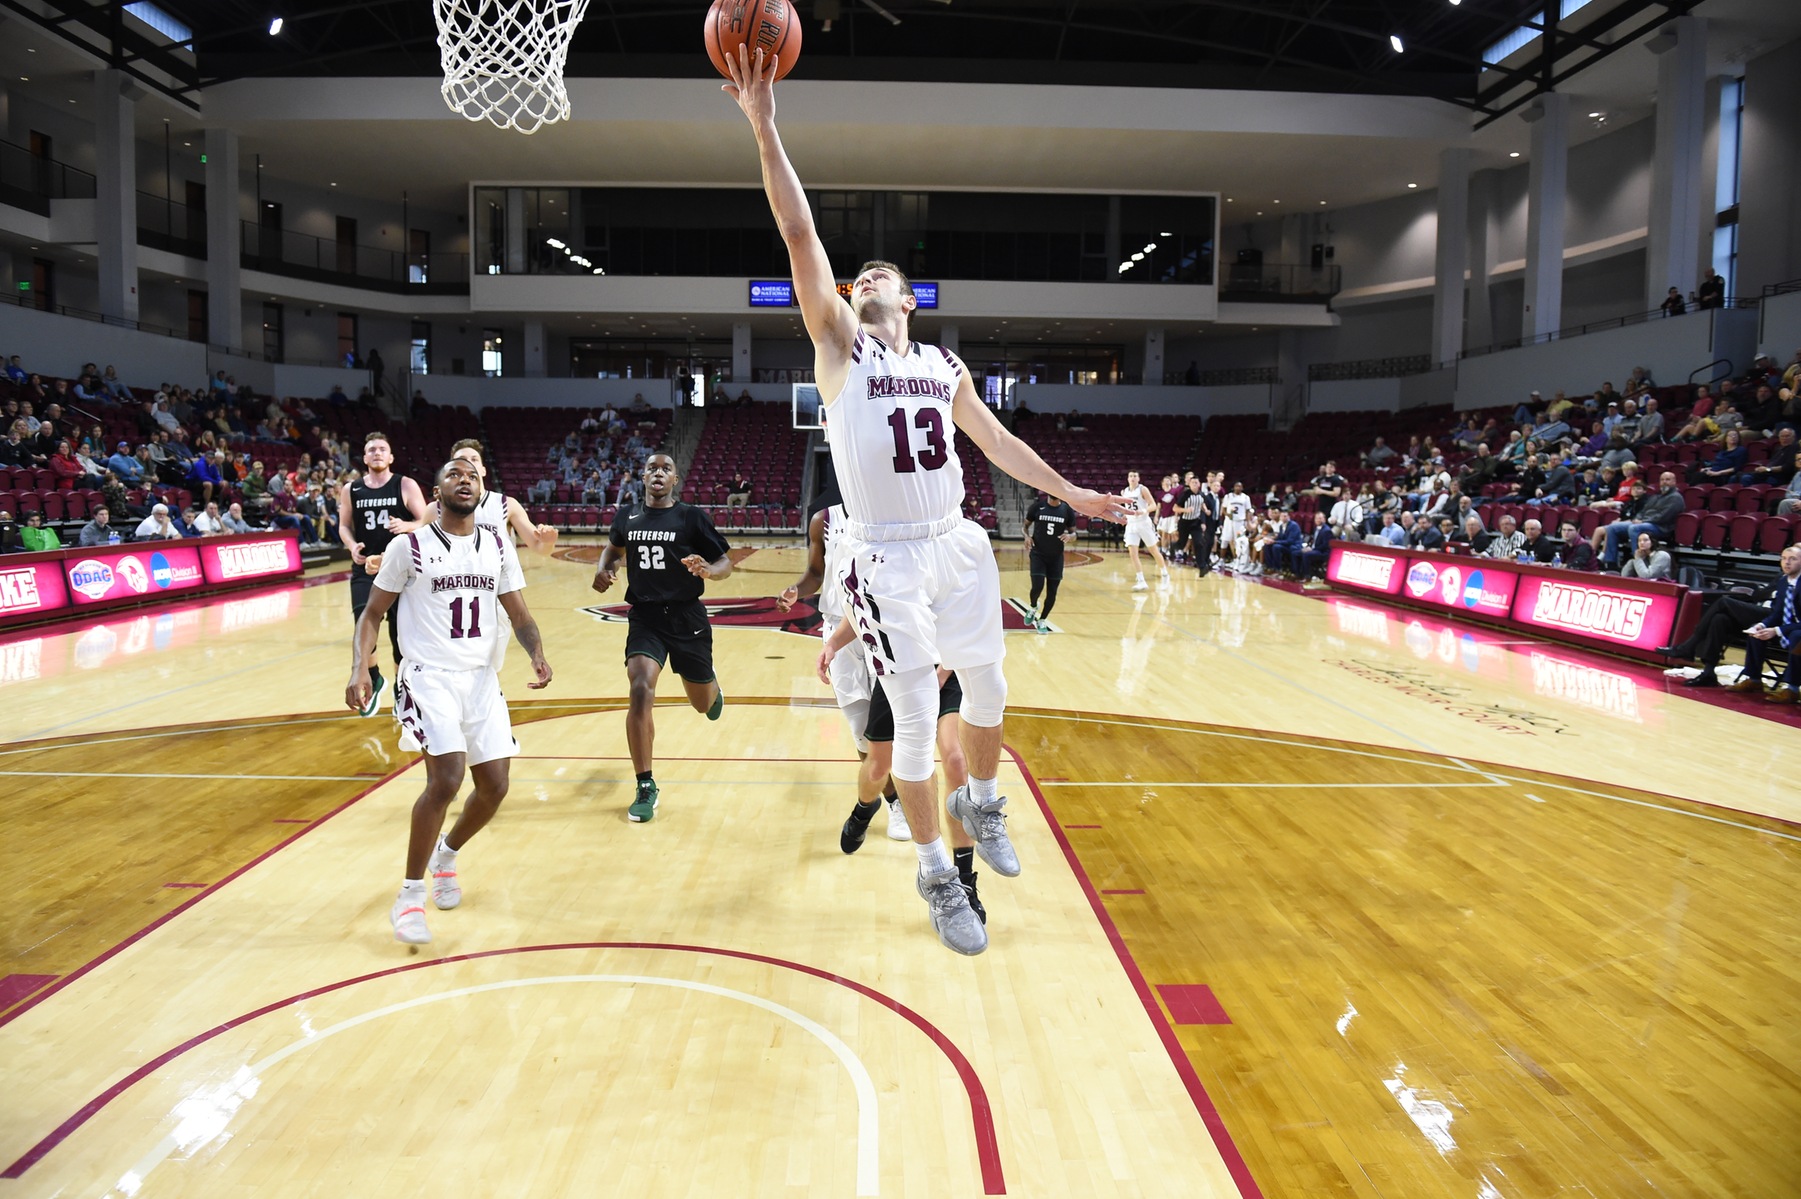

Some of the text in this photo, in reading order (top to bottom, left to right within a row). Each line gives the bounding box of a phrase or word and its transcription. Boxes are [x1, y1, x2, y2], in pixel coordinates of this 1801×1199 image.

[751, 20, 781, 58] ROC
[867, 374, 951, 405] MAROONS
[887, 407, 948, 473] 13
[356, 497, 397, 508] STEVENSON
[364, 509, 391, 531] 34
[1038, 514, 1065, 524] STEVENSON
[1047, 523, 1054, 535] 5
[628, 530, 676, 542] STEVENSON
[217, 540, 289, 579] MAROONS
[638, 545, 666, 570] 32
[72, 569, 111, 586] ODAC
[171, 566, 192, 578] Division
[1410, 569, 1435, 585] ODAC
[431, 574, 495, 593] MAROONS
[449, 596, 482, 639] 11
[1532, 581, 1653, 641] MAROONS
[1444, 706, 1538, 736] COURT
